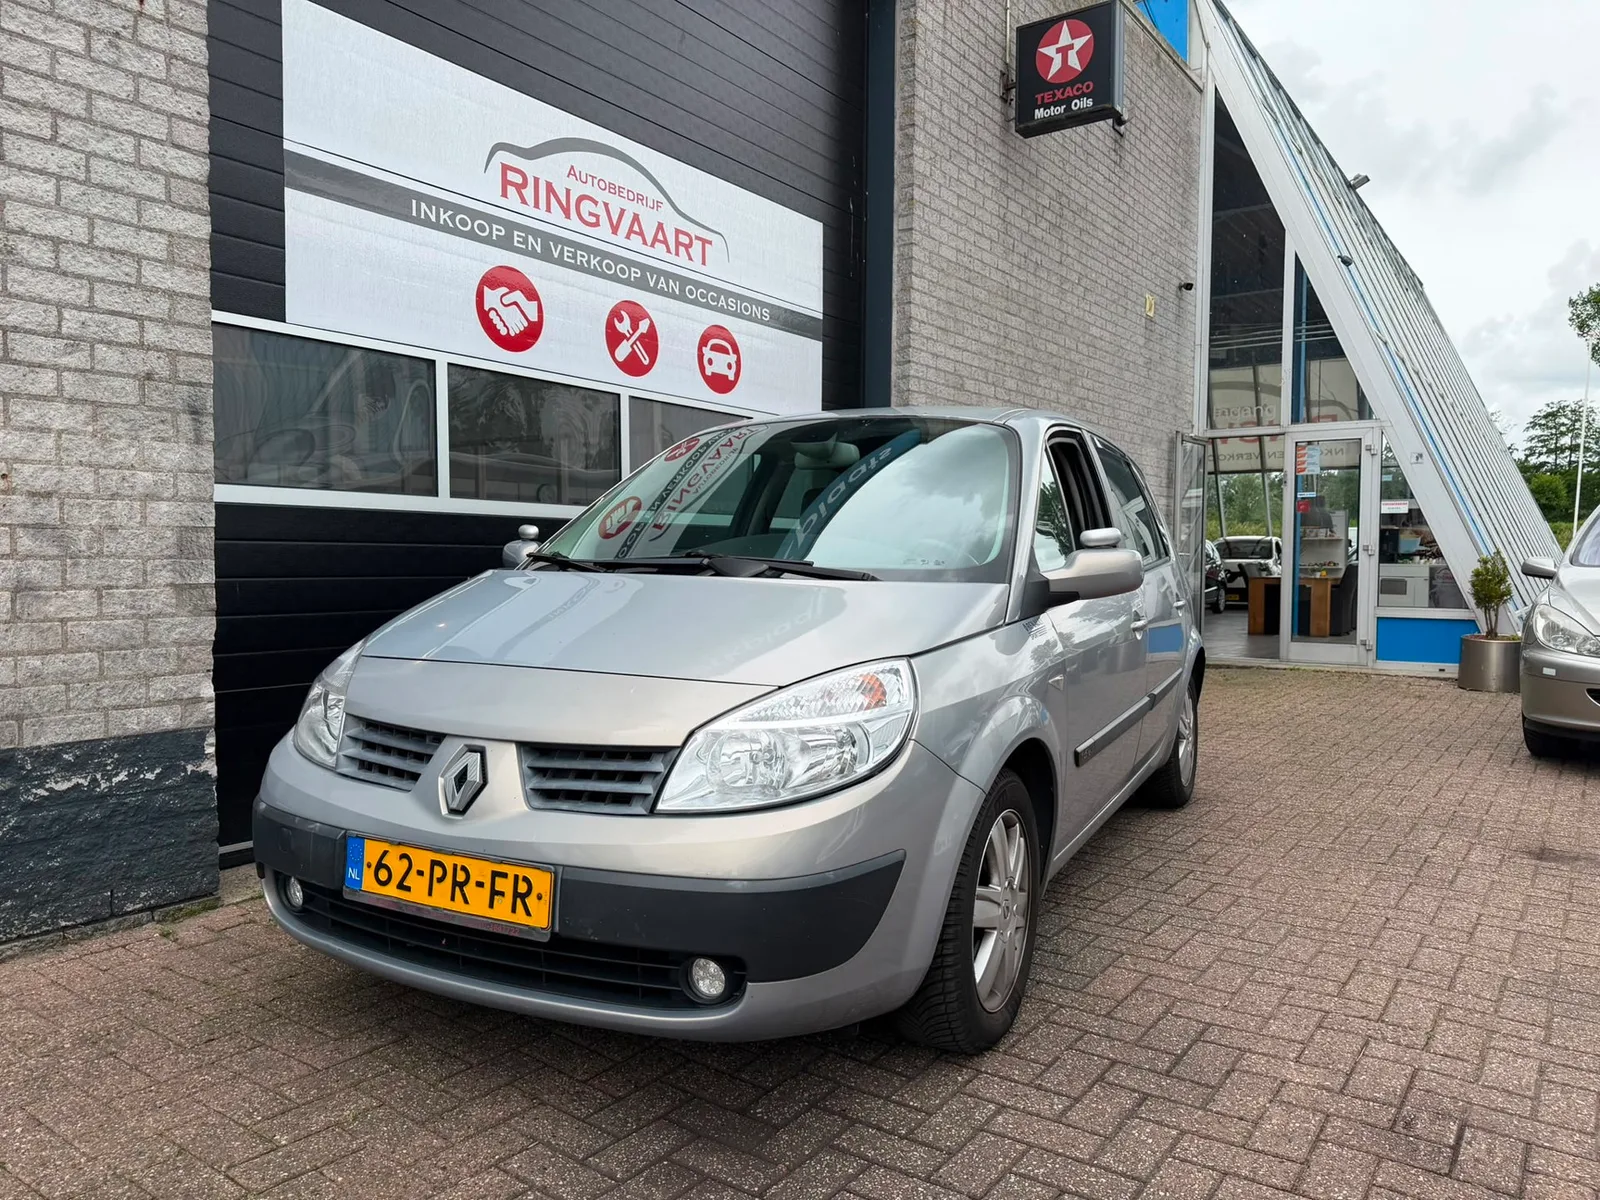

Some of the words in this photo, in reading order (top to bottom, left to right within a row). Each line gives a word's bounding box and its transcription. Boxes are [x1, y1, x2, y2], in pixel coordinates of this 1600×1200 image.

[1034, 104, 1067, 120] Motor
[1071, 97, 1094, 111] Oils
[1035, 81, 1094, 105] TEXACO
[566, 164, 664, 213] AUTOBEDRIJF
[499, 161, 713, 267] RINGVAART
[411, 199, 507, 242] INKOOP
[512, 231, 543, 255] EN
[549, 243, 642, 283] VERKOOP
[646, 273, 681, 296] VAN
[685, 284, 771, 322] OCCASIONS
[347, 866, 360, 881] NL
[373, 849, 533, 917] 62-PR-FR
